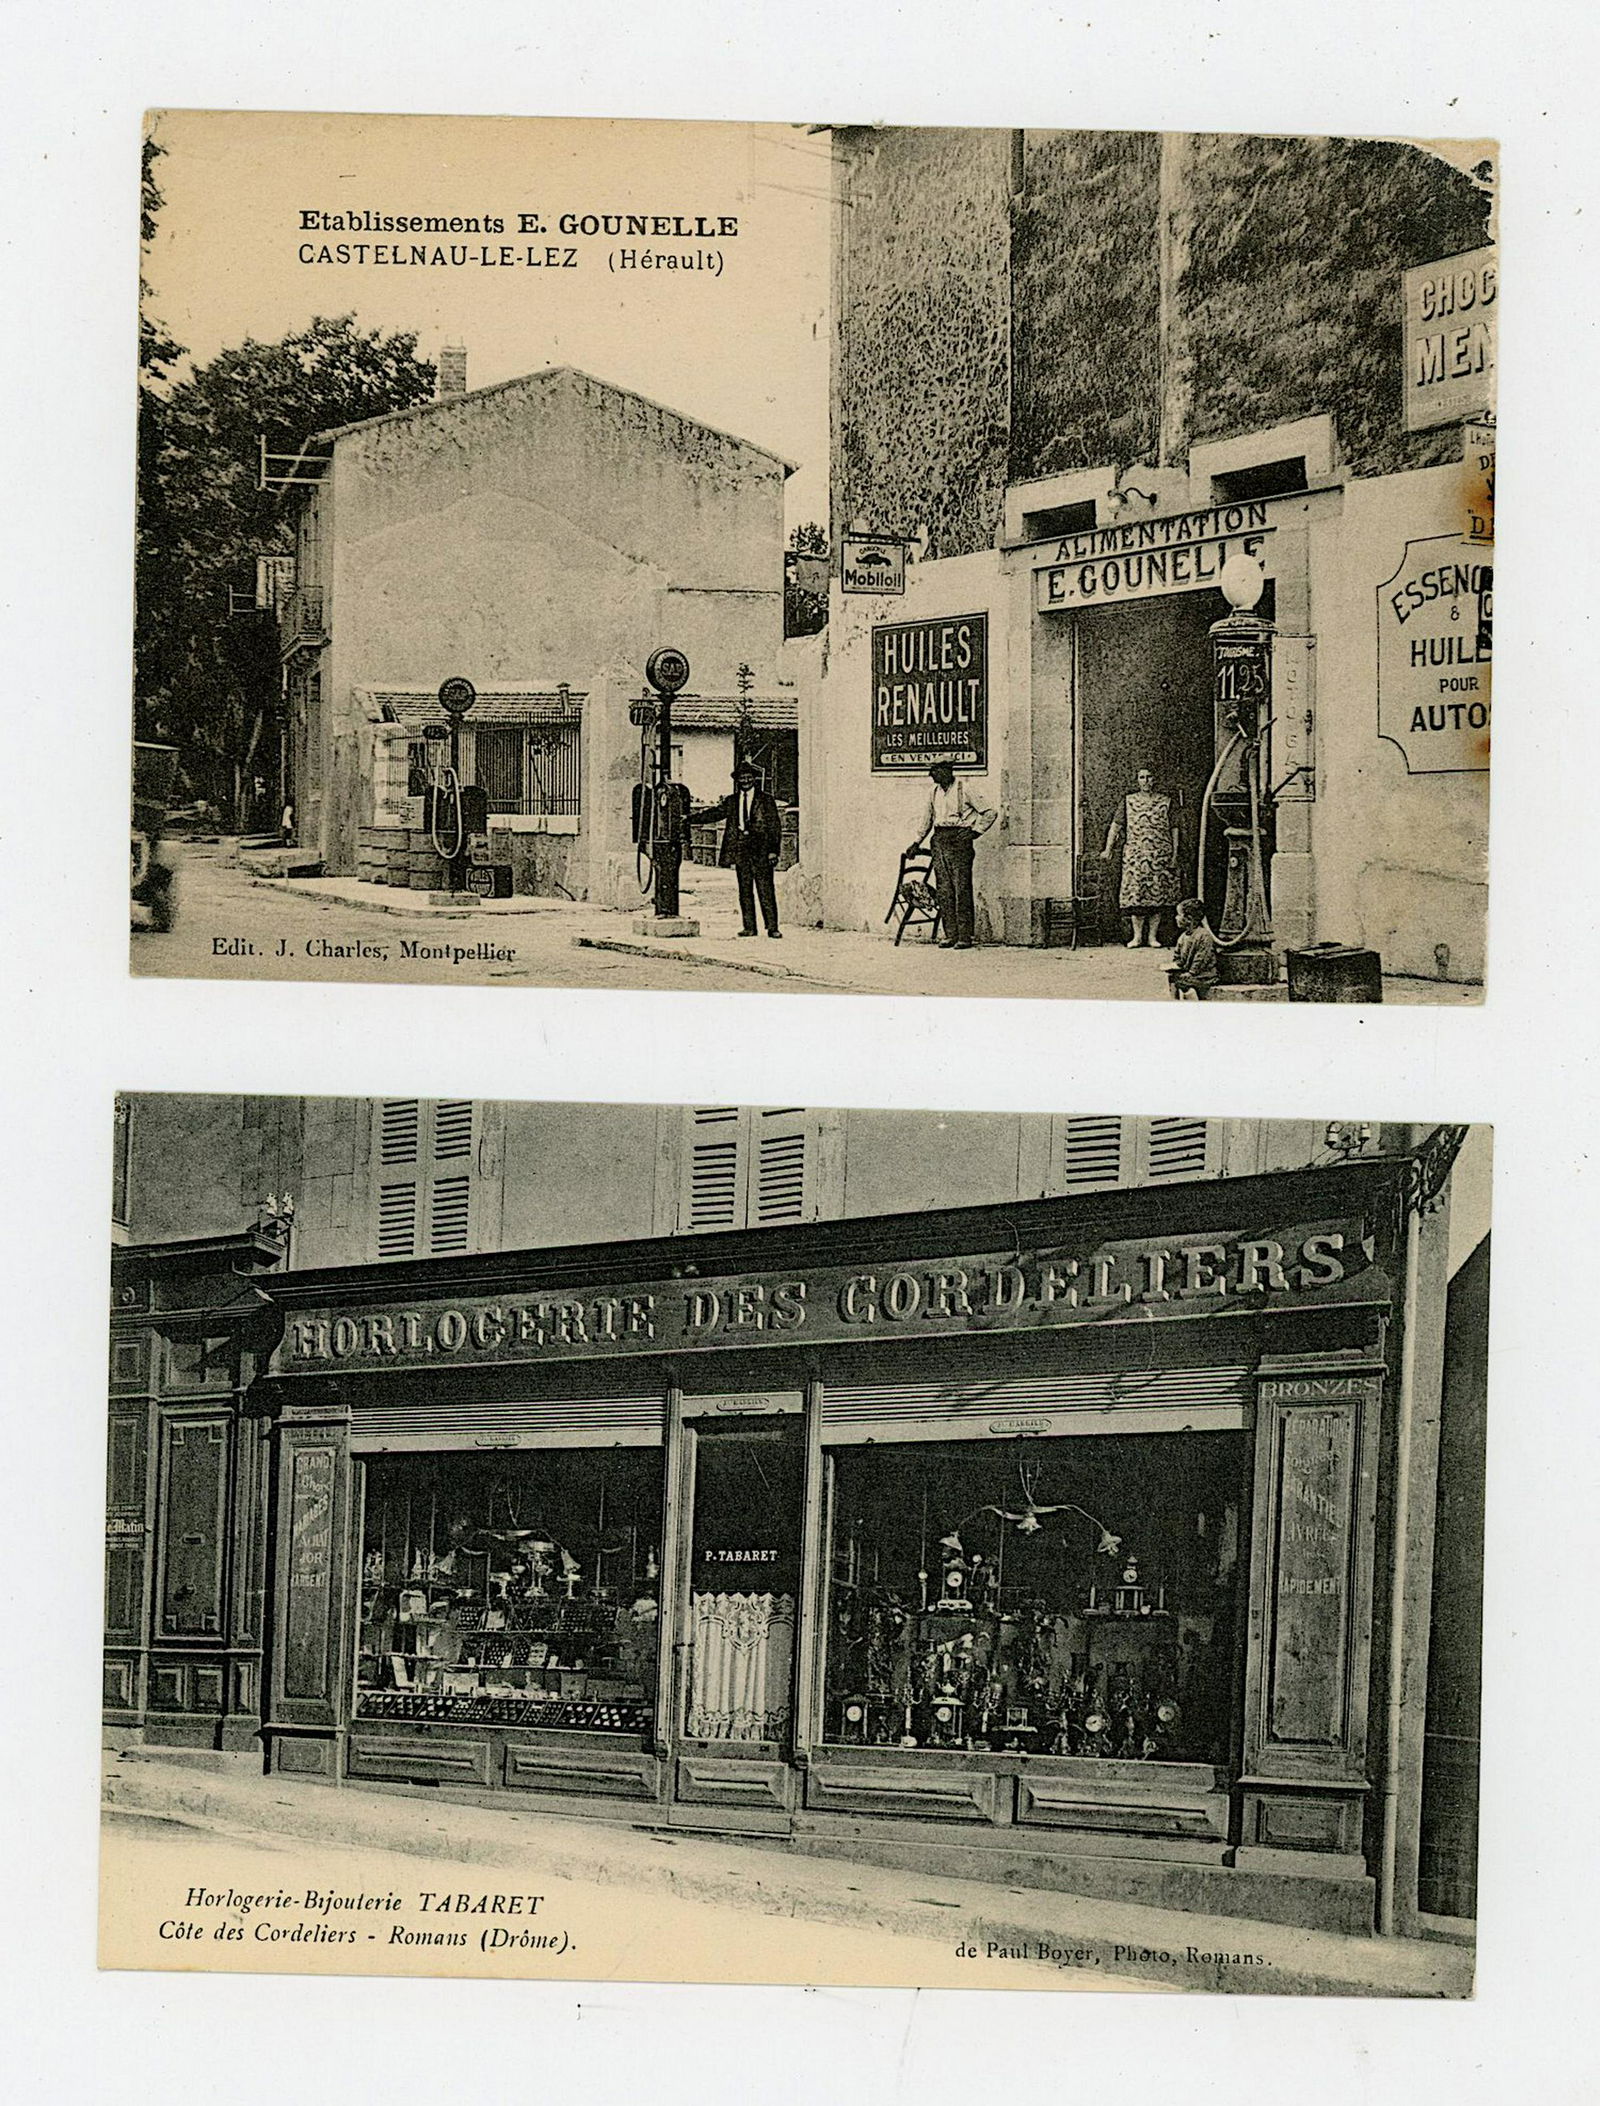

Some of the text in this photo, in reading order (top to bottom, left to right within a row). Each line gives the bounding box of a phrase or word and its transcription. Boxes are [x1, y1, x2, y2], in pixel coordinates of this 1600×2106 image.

[1055, 502, 1267, 562] ALIMENTATION
[884, 625, 971, 675] HUILES
[1439, 676, 1480, 693] POUR
[877, 679, 980, 727] RENAULT
[1410, 702, 1492, 733] AUTO
[887, 731, 969, 747] LES MEILLEURES
[890, 754, 905, 763] EN
[290, 1233, 1344, 1361] HORLOGERIE DES CORDELIERS
[1261, 1379, 1379, 1398] BRONZES
